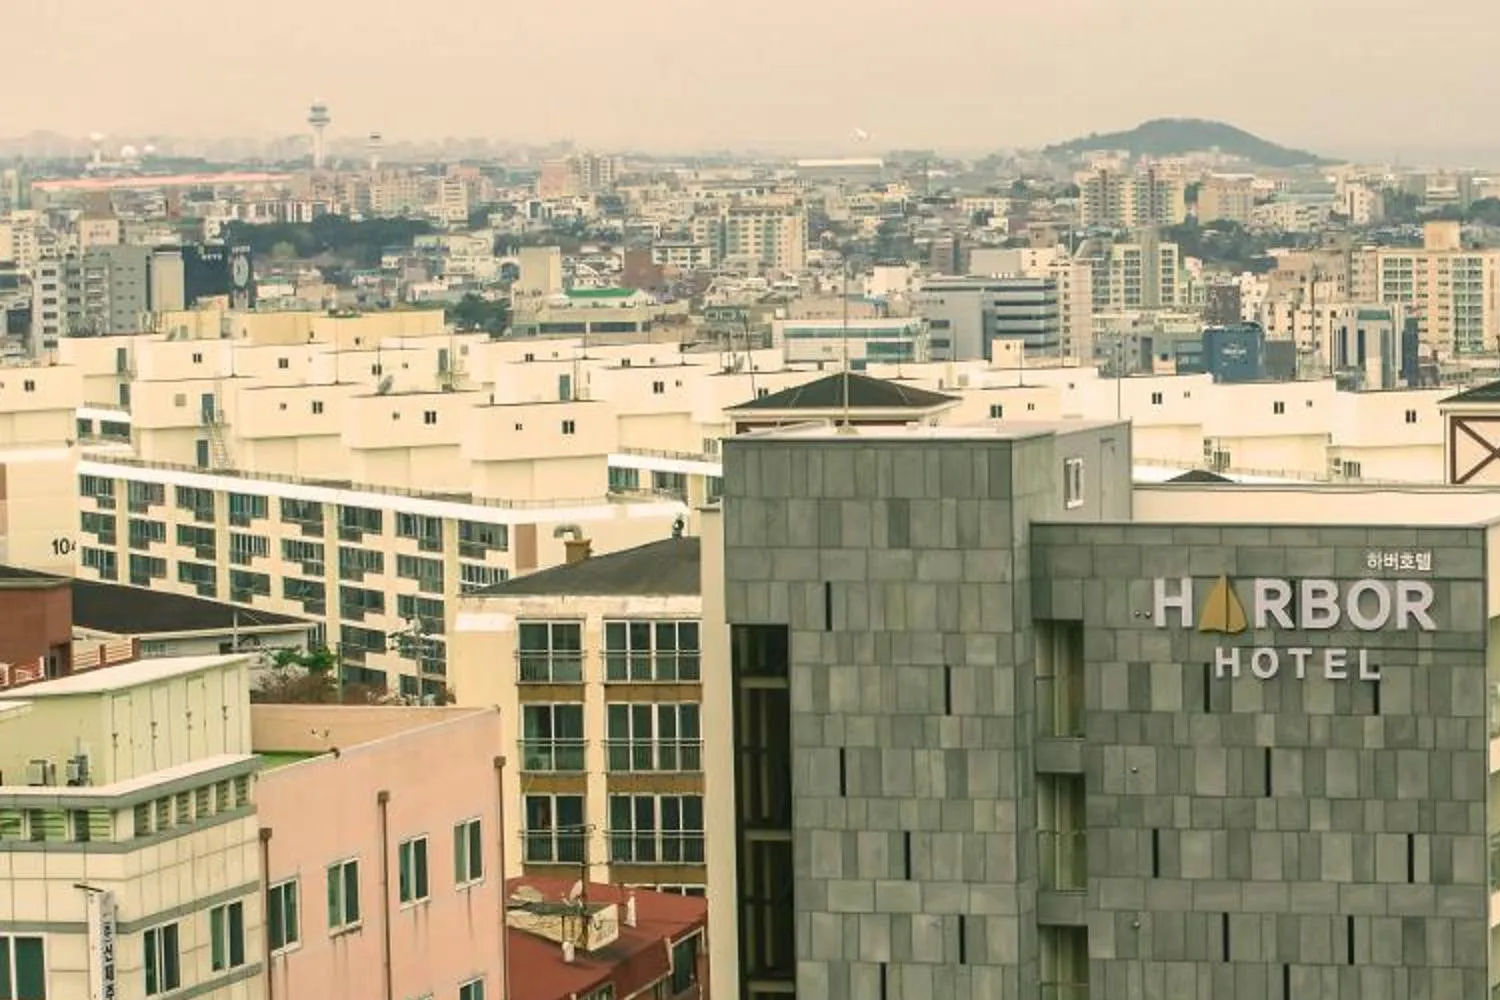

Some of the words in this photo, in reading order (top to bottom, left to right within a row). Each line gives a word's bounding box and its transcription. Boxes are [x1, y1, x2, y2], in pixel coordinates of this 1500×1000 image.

[1366, 550, 1432, 571] 하버호텔
[1153, 574, 1437, 634] HARBOR
[1215, 646, 1381, 681] HOTEL
